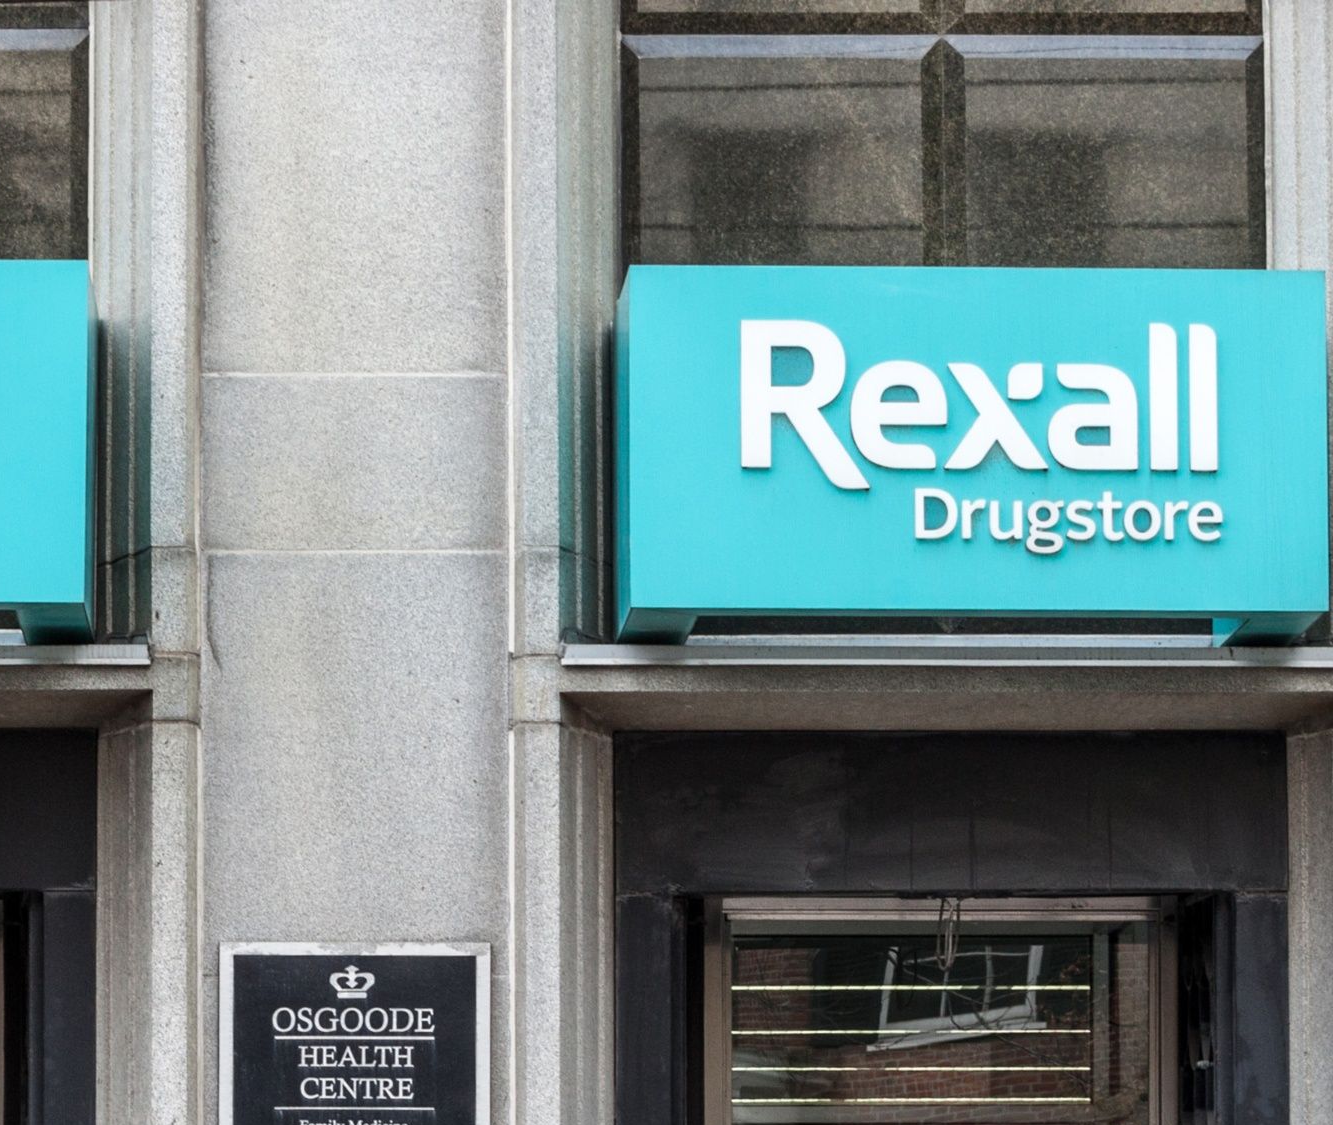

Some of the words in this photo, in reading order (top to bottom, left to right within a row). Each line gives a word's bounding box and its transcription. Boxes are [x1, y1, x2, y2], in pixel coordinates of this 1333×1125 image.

[740, 319, 1218, 490] Rexall
[913, 487, 1223, 554] Drugstore
[271, 1006, 436, 1033] OSGOODE
[297, 1045, 415, 1068] HEALTH
[299, 1077, 415, 1100] CENTRE
